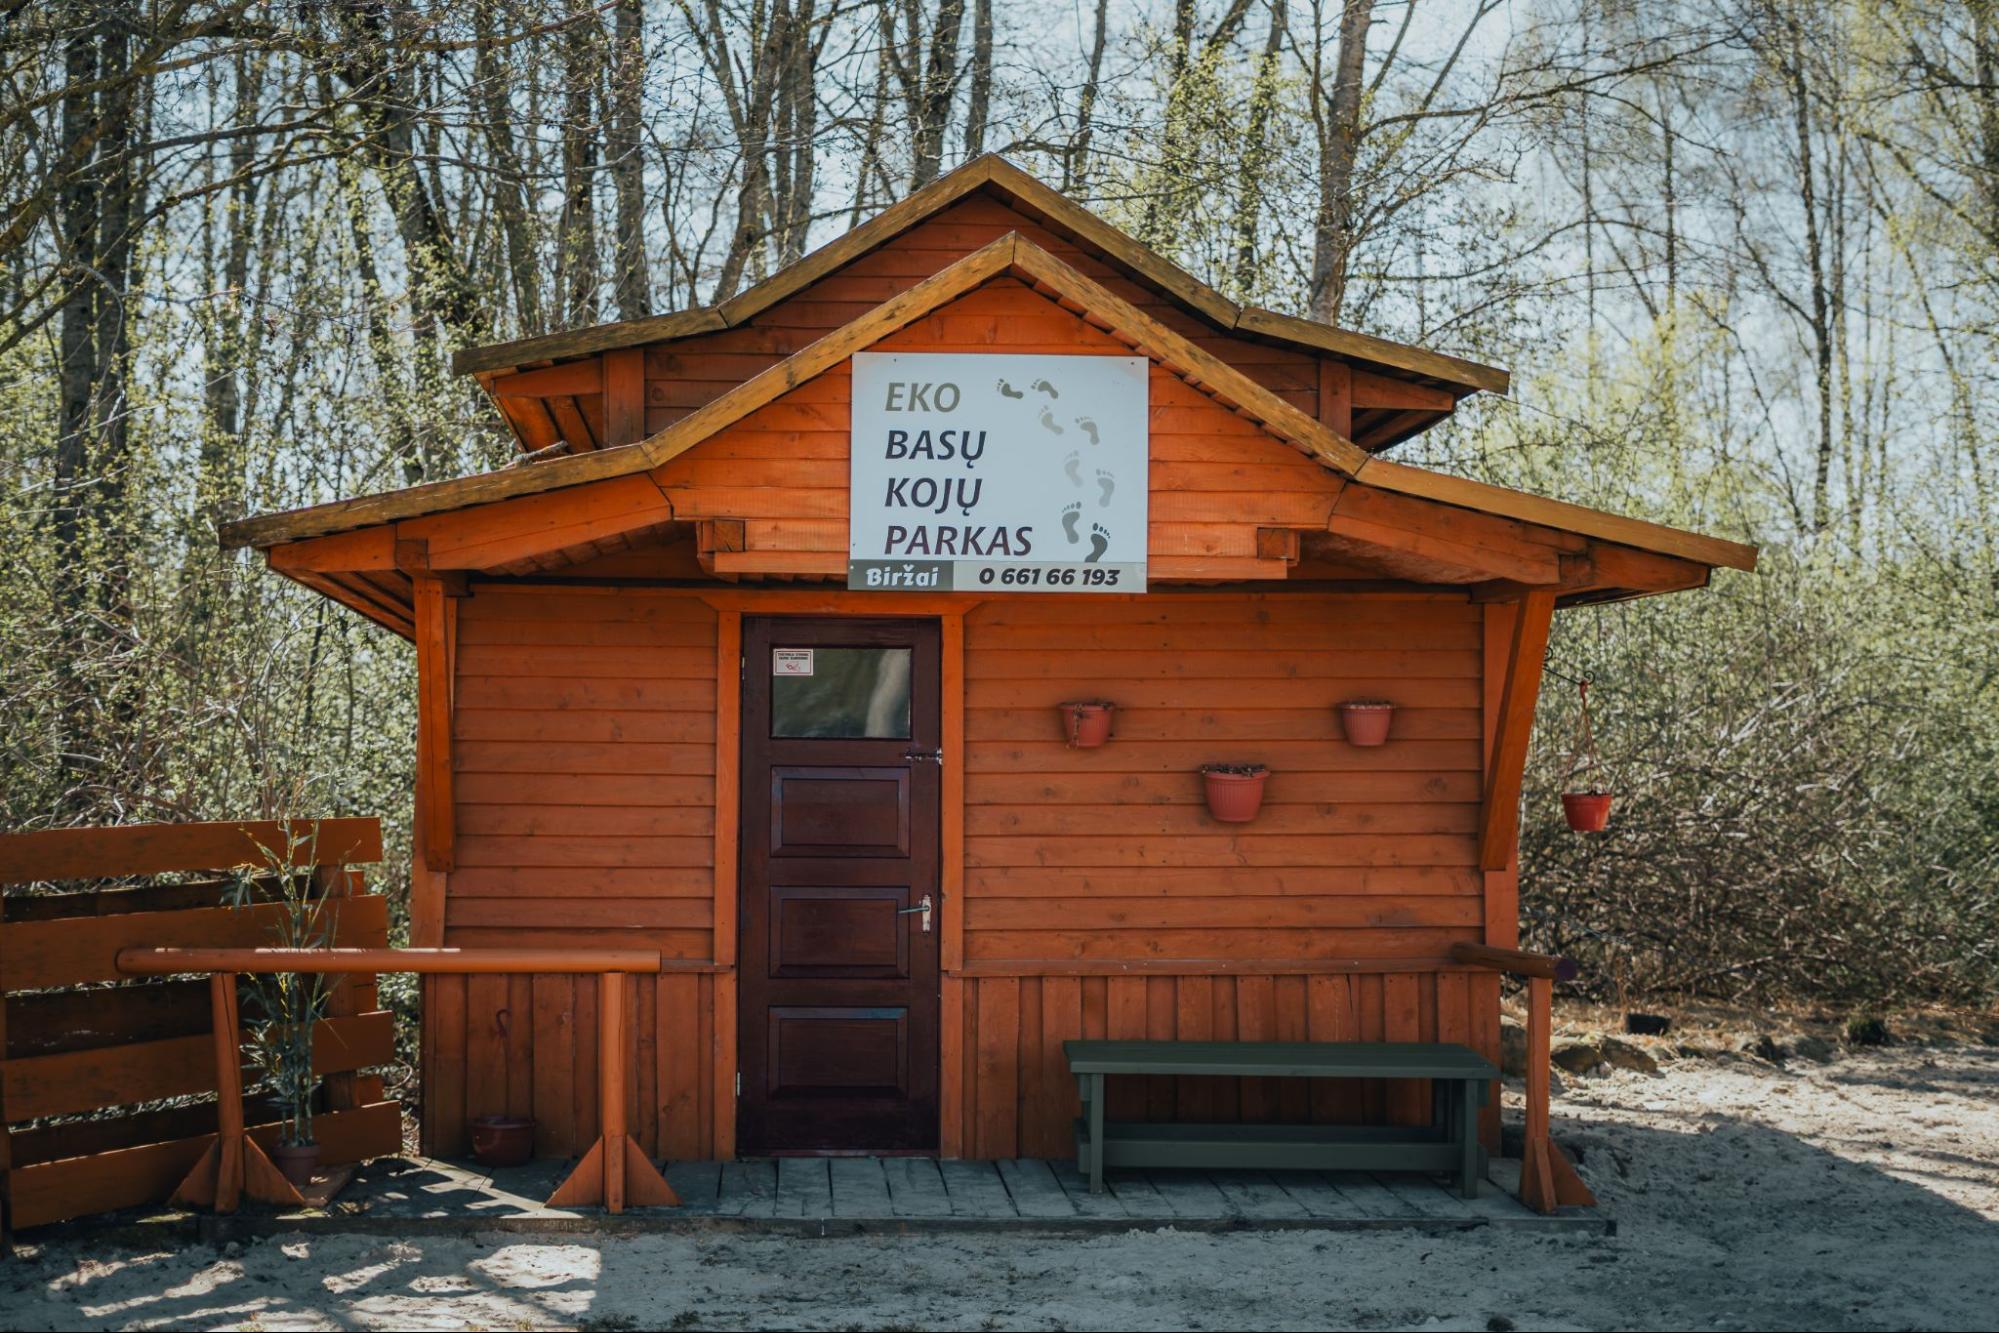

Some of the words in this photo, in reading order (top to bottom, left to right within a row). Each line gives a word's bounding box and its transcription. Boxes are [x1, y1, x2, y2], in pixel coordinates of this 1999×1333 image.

[884, 382, 961, 413] EKO
[885, 430, 987, 469] BASŲ
[884, 477, 983, 516] KOJŲ
[884, 525, 1033, 556] PARKAS
[866, 564, 938, 587] Biržai
[979, 567, 995, 585] 0
[1001, 568, 1041, 585] 661
[1046, 568, 1075, 585] 66
[1082, 568, 1120, 586] 193
